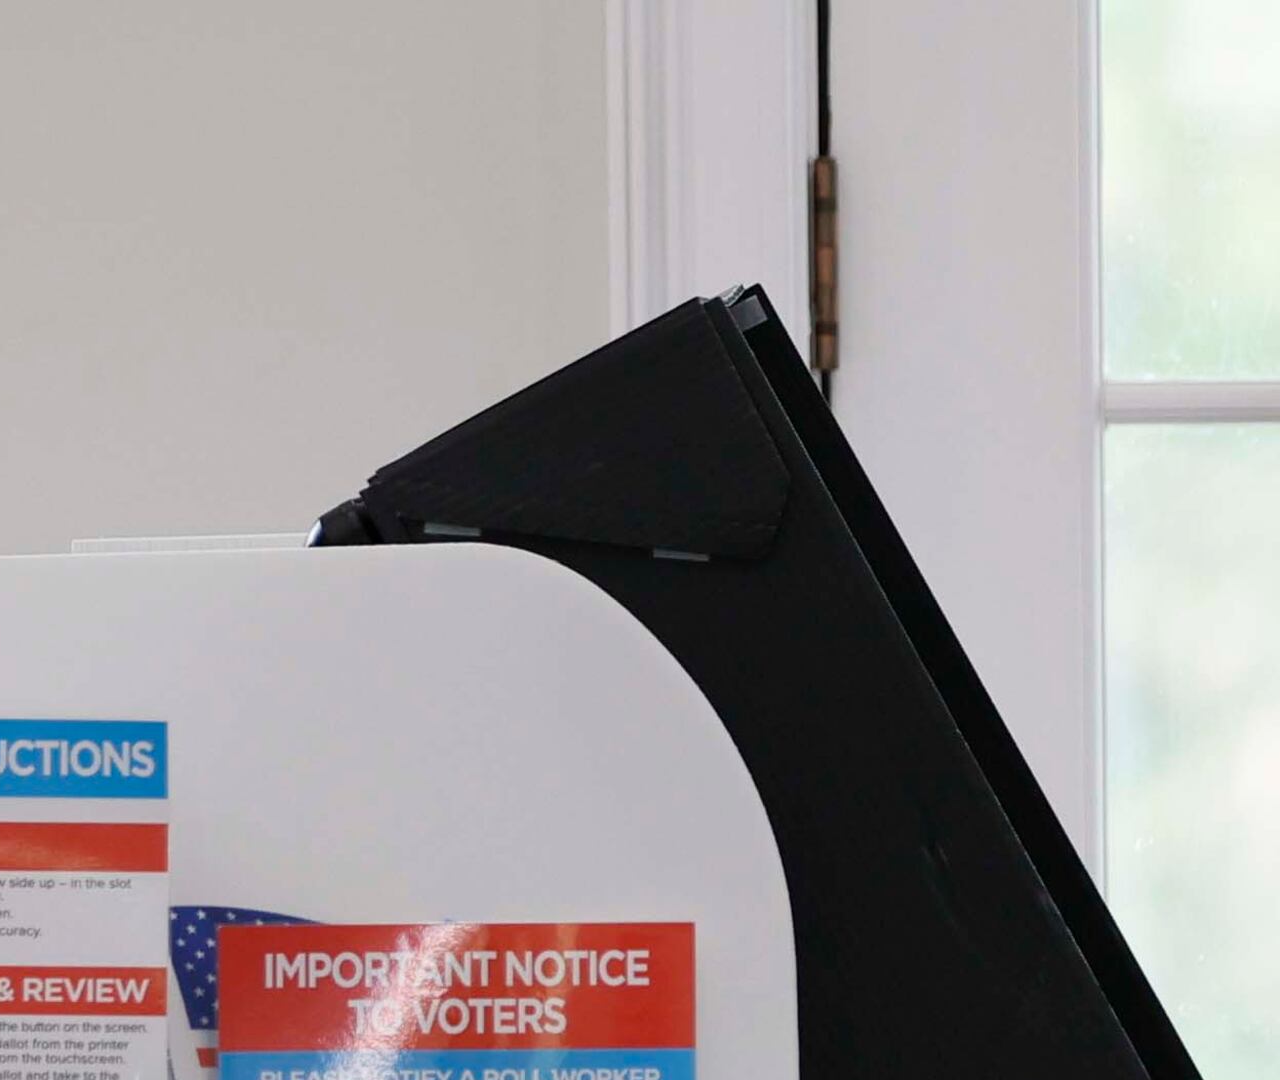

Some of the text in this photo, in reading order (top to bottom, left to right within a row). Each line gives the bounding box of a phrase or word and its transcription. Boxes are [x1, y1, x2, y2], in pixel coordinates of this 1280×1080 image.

[263, 949, 650, 988] IMPORTANT NOTICE
[22, 977, 149, 1004] REVIEW
[414, 998, 568, 1035] VOTERS
